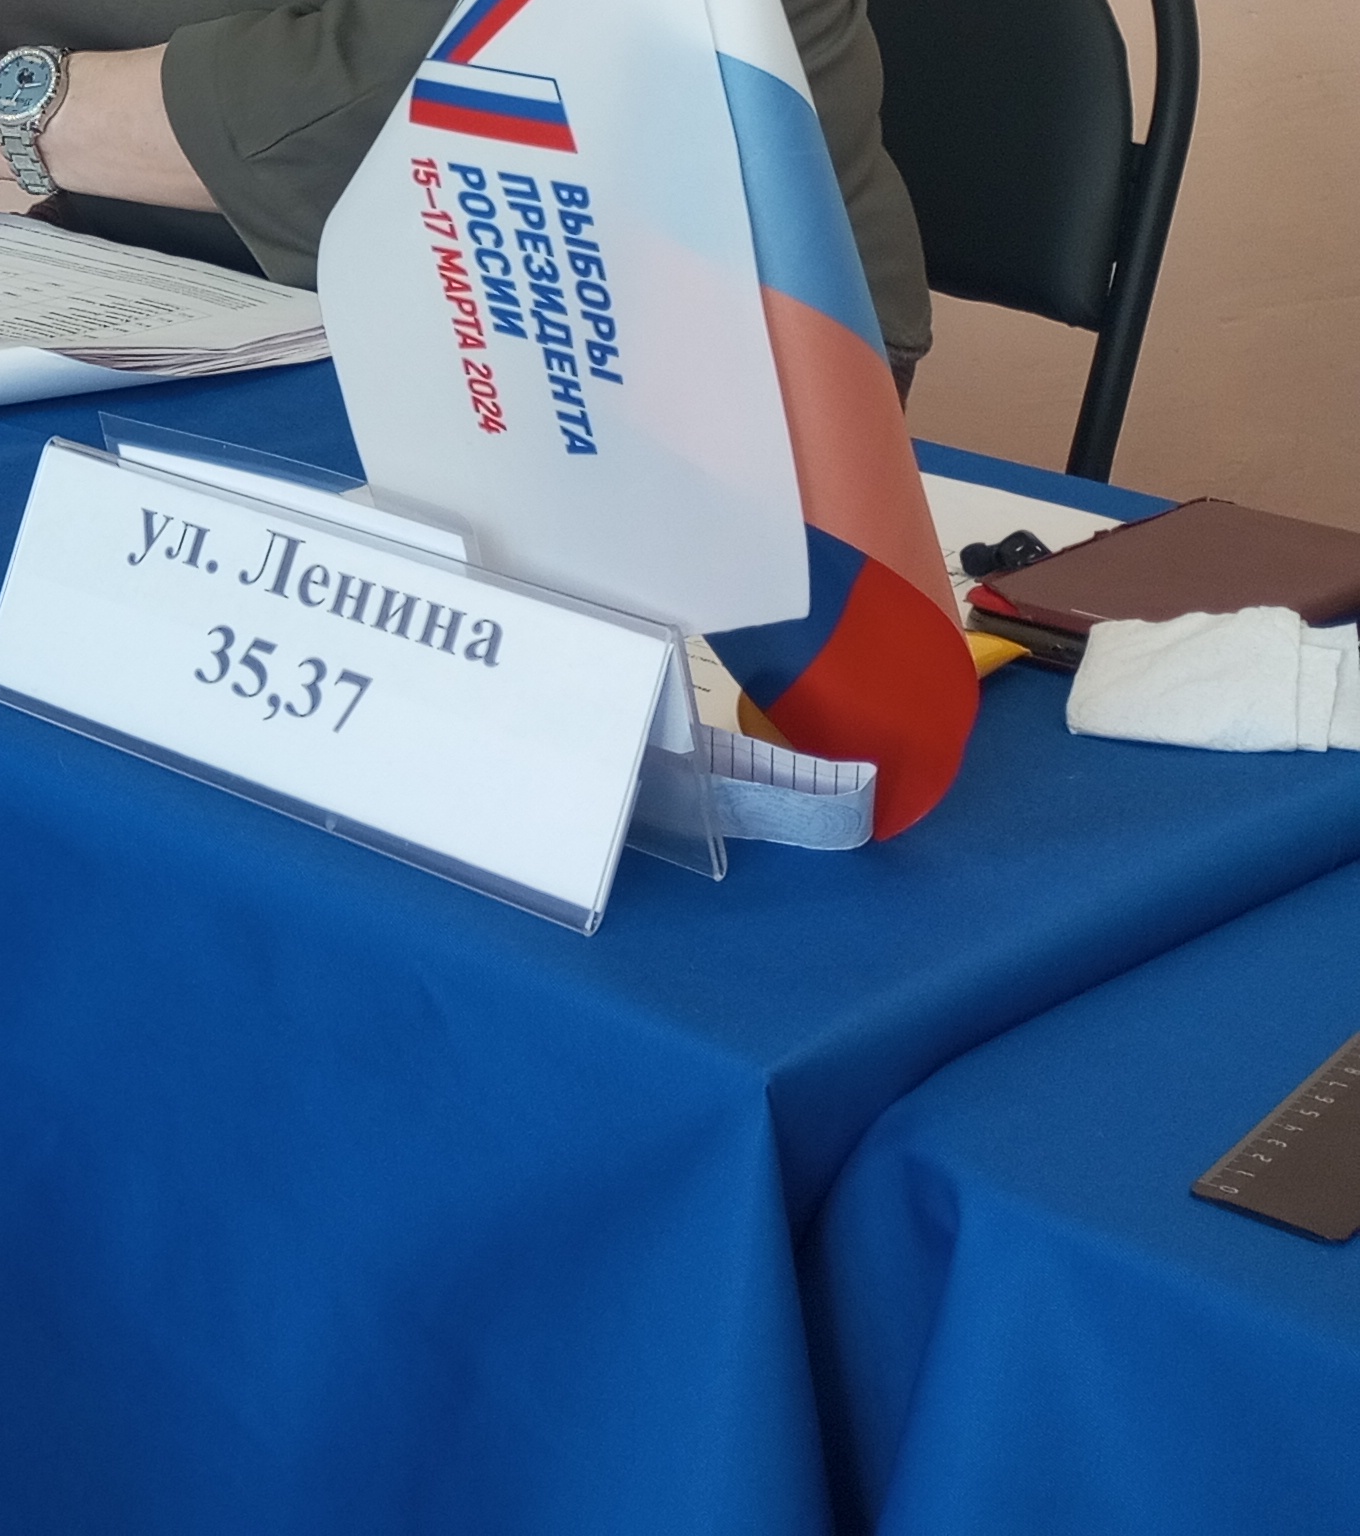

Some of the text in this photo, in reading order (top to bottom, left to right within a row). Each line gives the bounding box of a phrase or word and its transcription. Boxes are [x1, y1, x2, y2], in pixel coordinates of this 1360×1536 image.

[447, 161, 528, 340] РОССИИ
[497, 170, 599, 456] ПРЕЗИДЕНТА
[551, 179, 624, 386] ВЫБОРЫ
[431, 245, 487, 350] МАРТА
[462, 357, 508, 436] 2024
[127, 507, 506, 667] ул. Ленина
[194, 624, 374, 734] 35,37
[1252, 1153, 1273, 1163] 2
[1267, 1138, 1287, 1148] 3
[1299, 1109, 1320, 1118] 5
